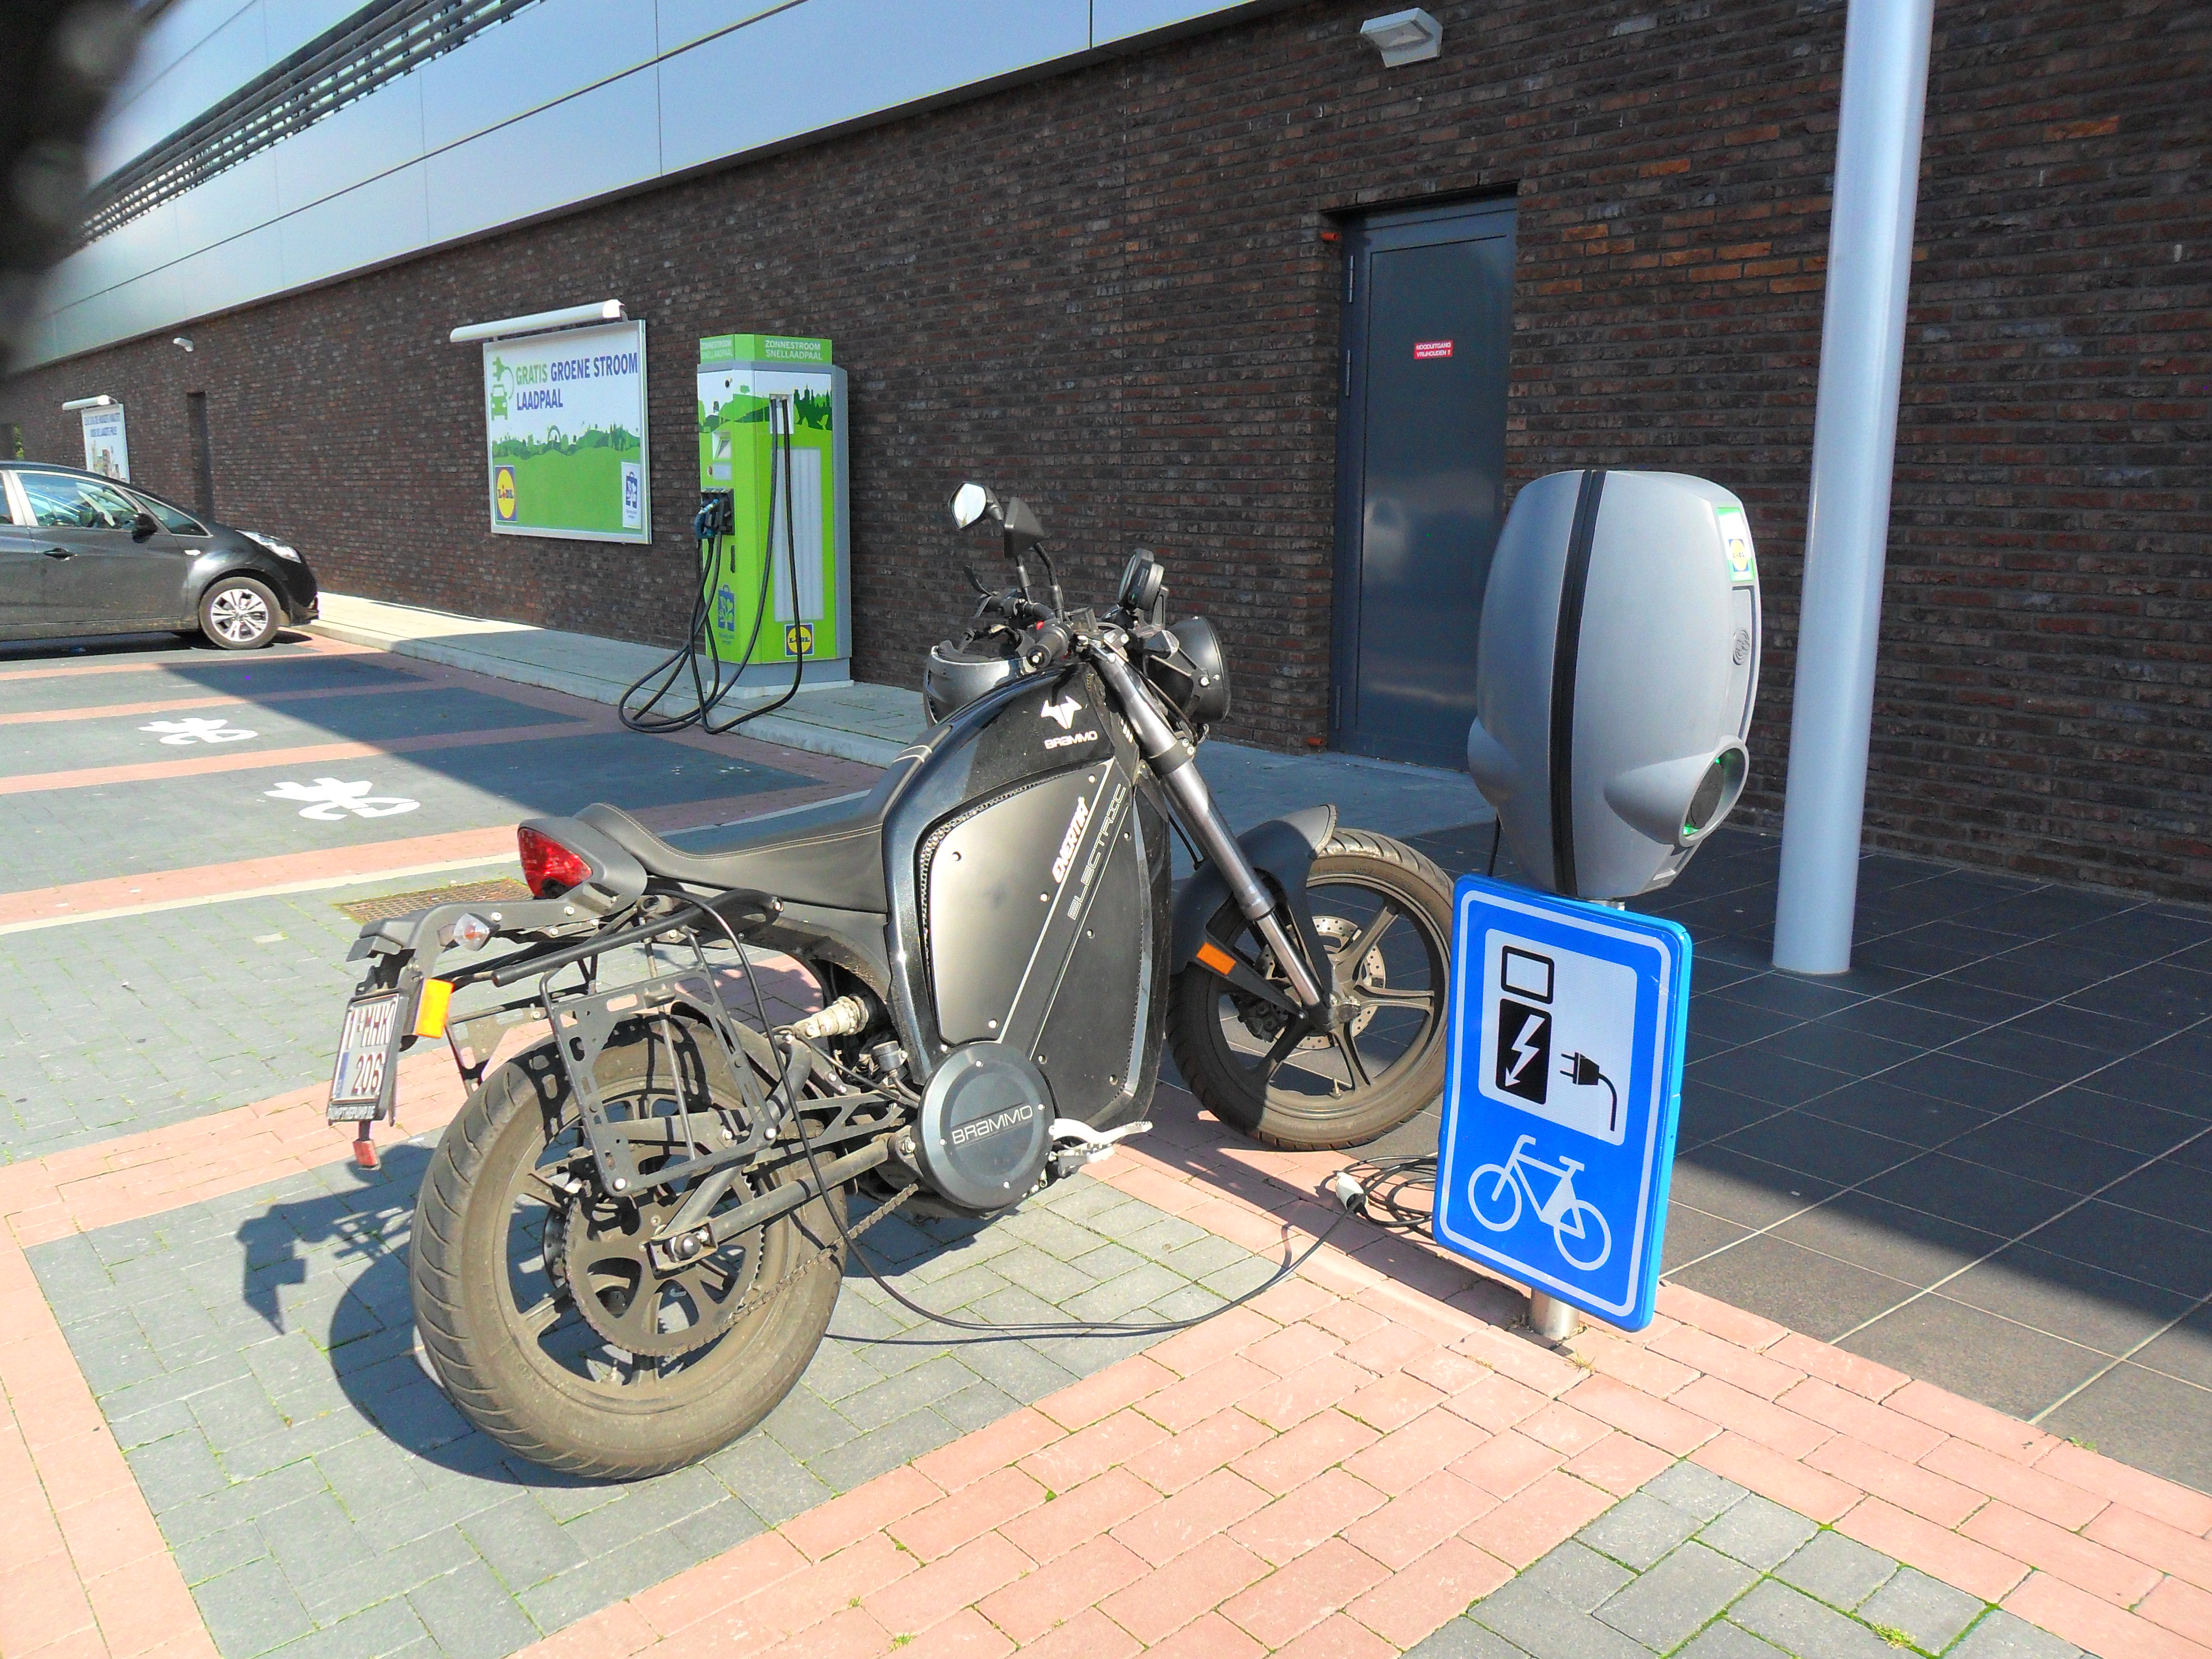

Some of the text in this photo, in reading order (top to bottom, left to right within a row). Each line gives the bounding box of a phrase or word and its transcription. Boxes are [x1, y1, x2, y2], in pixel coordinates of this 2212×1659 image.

[765, 340, 821, 351] ZONNESTROOM
[765, 349, 822, 360] SNELLAADPAAL
[516, 352, 638, 385] GRATIS GROENE STROOM
[517, 388, 564, 411] LAADPAAL
[1067, 783, 1126, 920] ELECTRIC
[350, 1051, 385, 1096] 206
